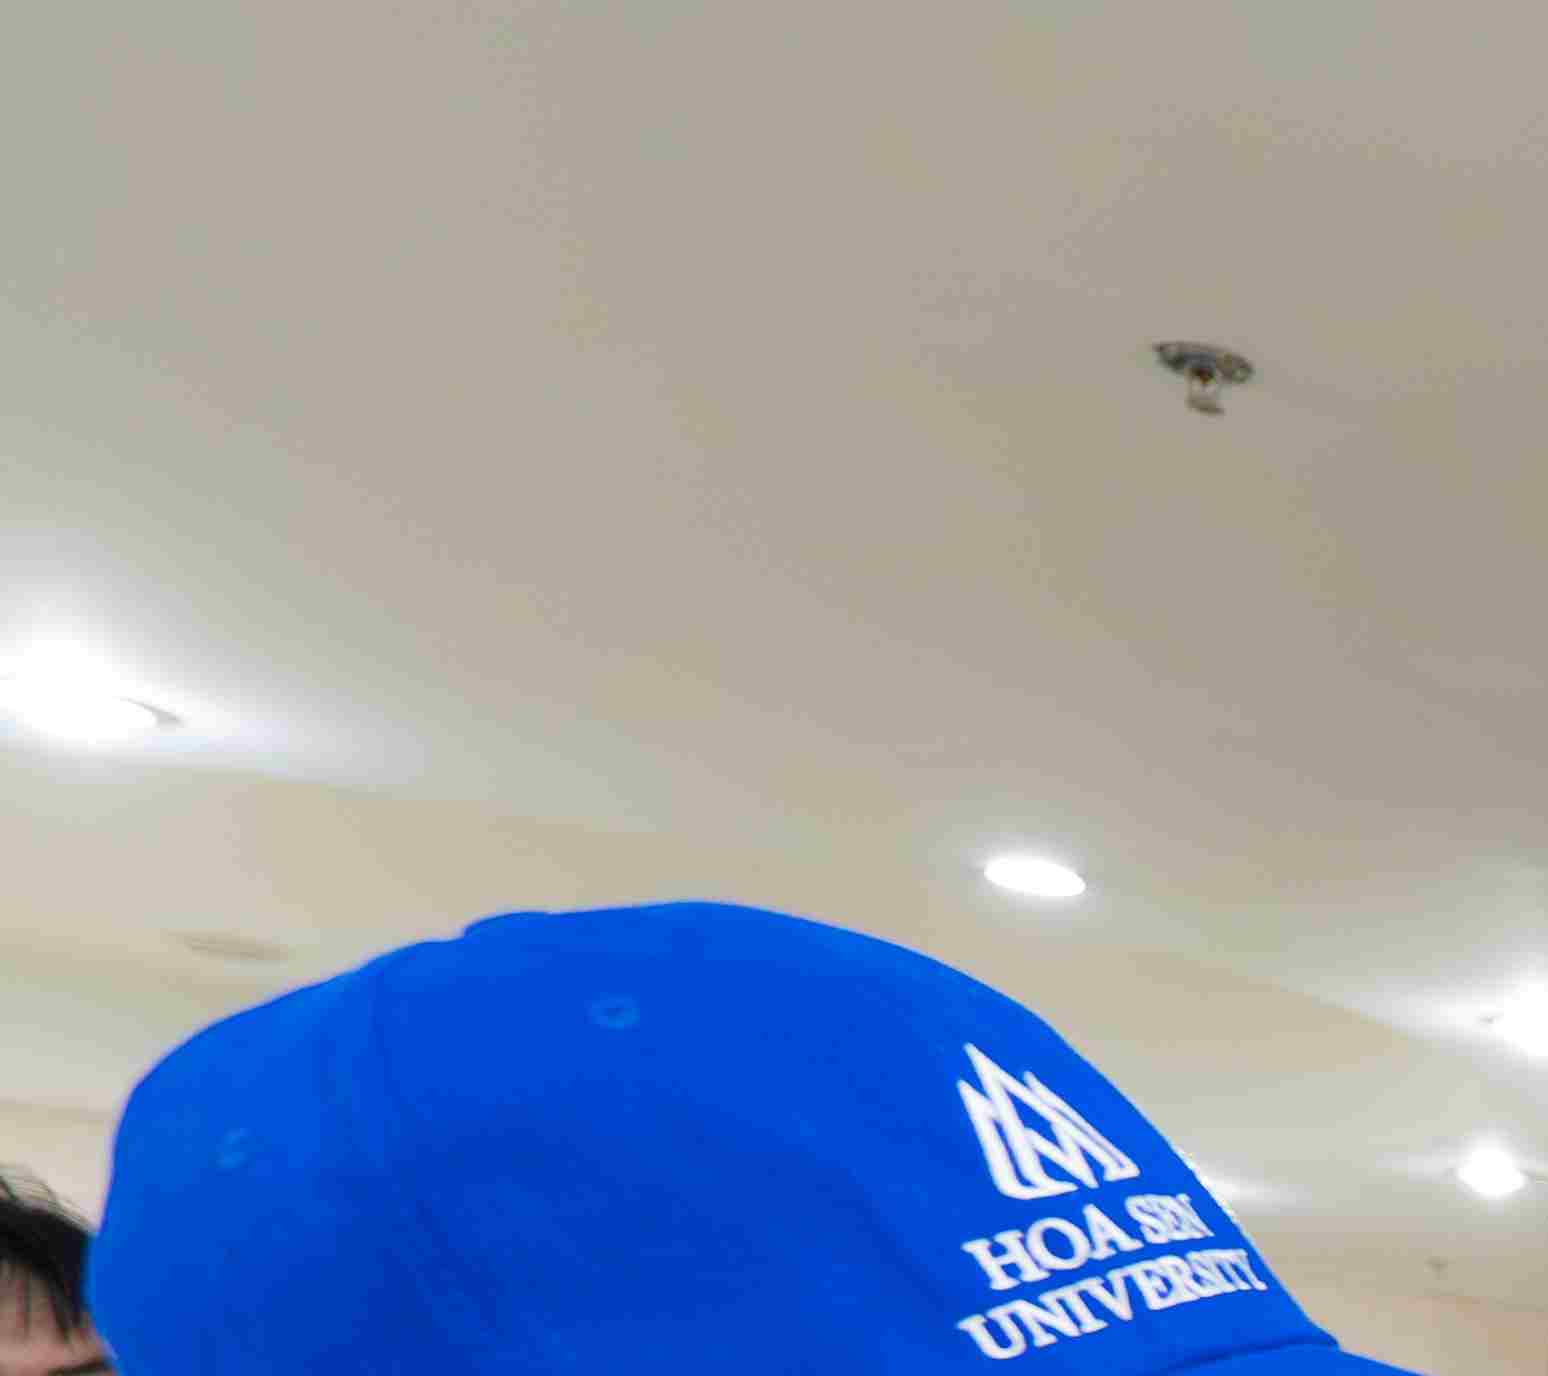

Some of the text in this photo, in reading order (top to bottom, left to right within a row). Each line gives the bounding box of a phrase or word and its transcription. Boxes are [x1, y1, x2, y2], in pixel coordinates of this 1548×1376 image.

[961, 1194, 1215, 1291] HOA SEN
[955, 1248, 1268, 1360] UNIVERSITY
